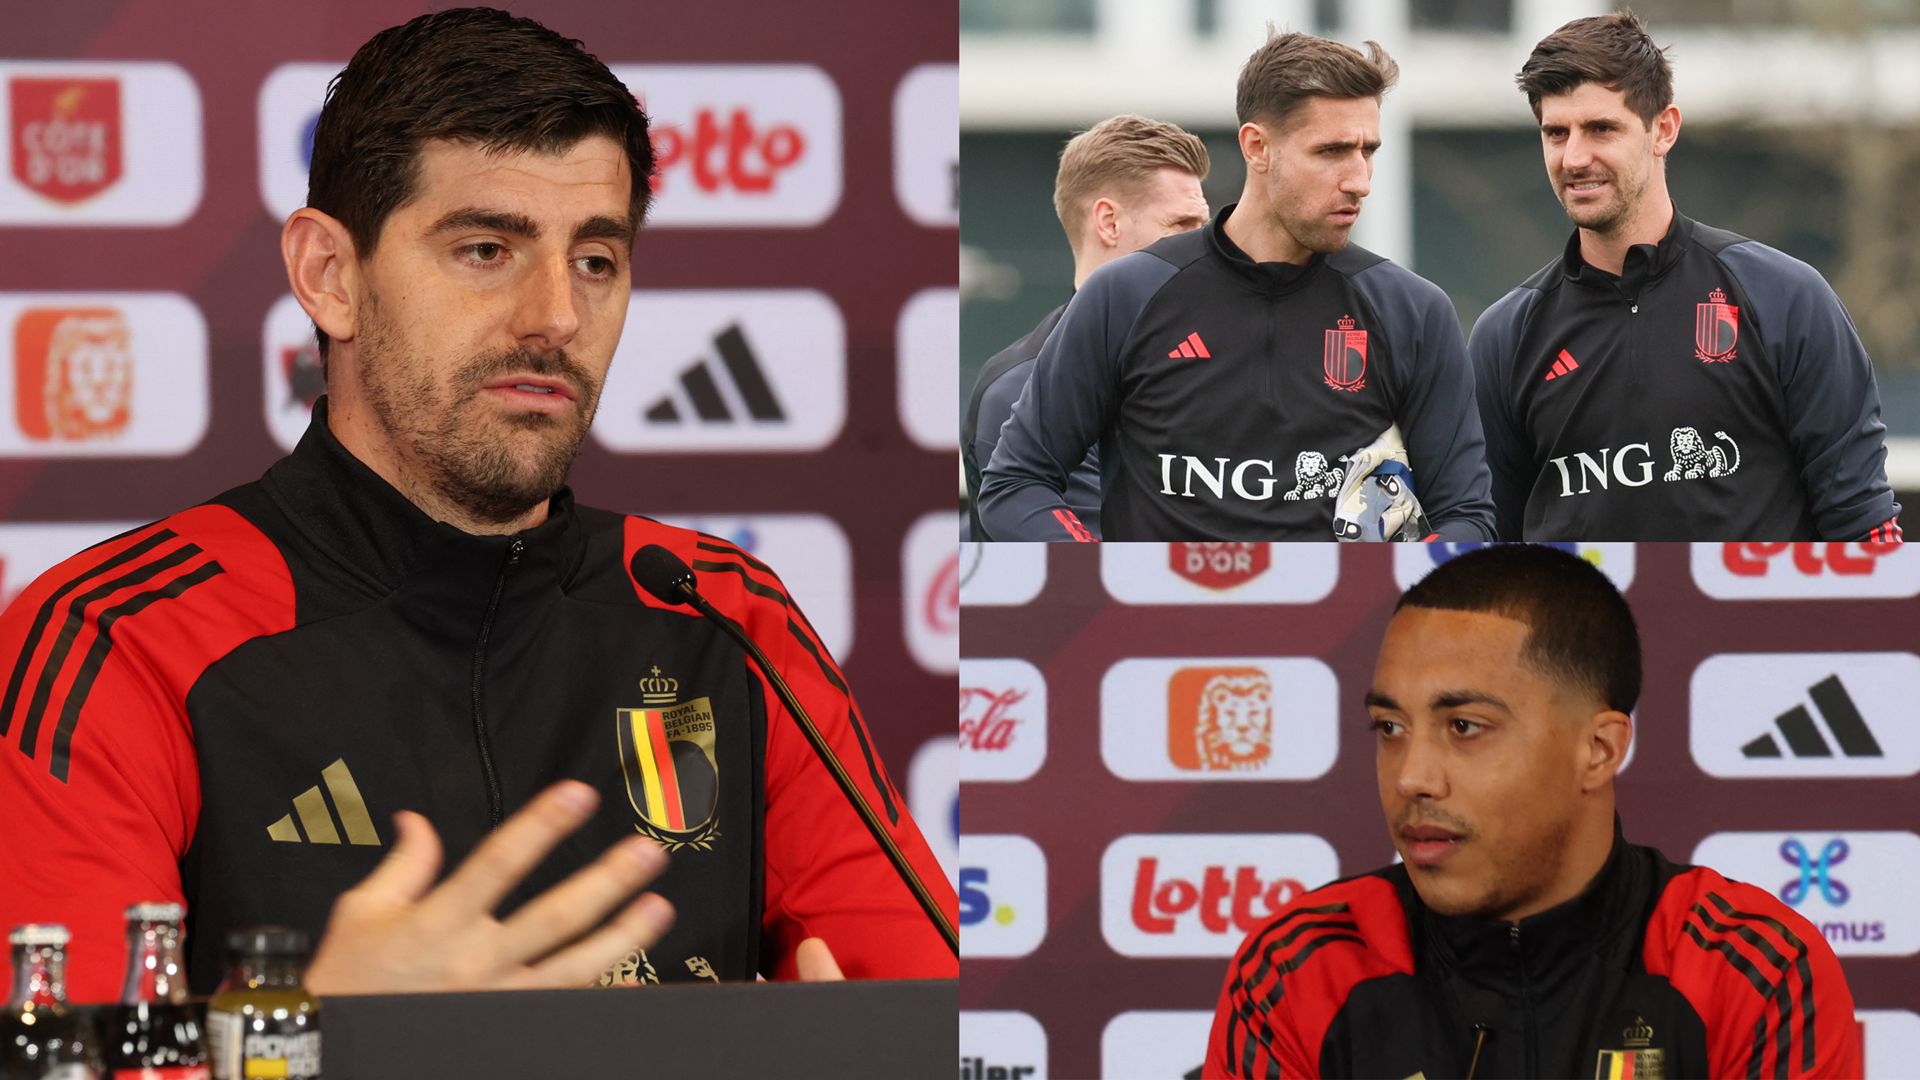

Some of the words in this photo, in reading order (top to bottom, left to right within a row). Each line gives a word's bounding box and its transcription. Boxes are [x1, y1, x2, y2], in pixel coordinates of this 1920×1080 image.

[648, 108, 807, 193] otto
[1158, 453, 1278, 501] ING
[1549, 442, 1655, 497] ING
[1185, 551, 1253, 574] D'OR
[662, 704, 697, 720] ROYAL
[664, 711, 711, 730] BELGIAN
[1816, 921, 1887, 942] mus
